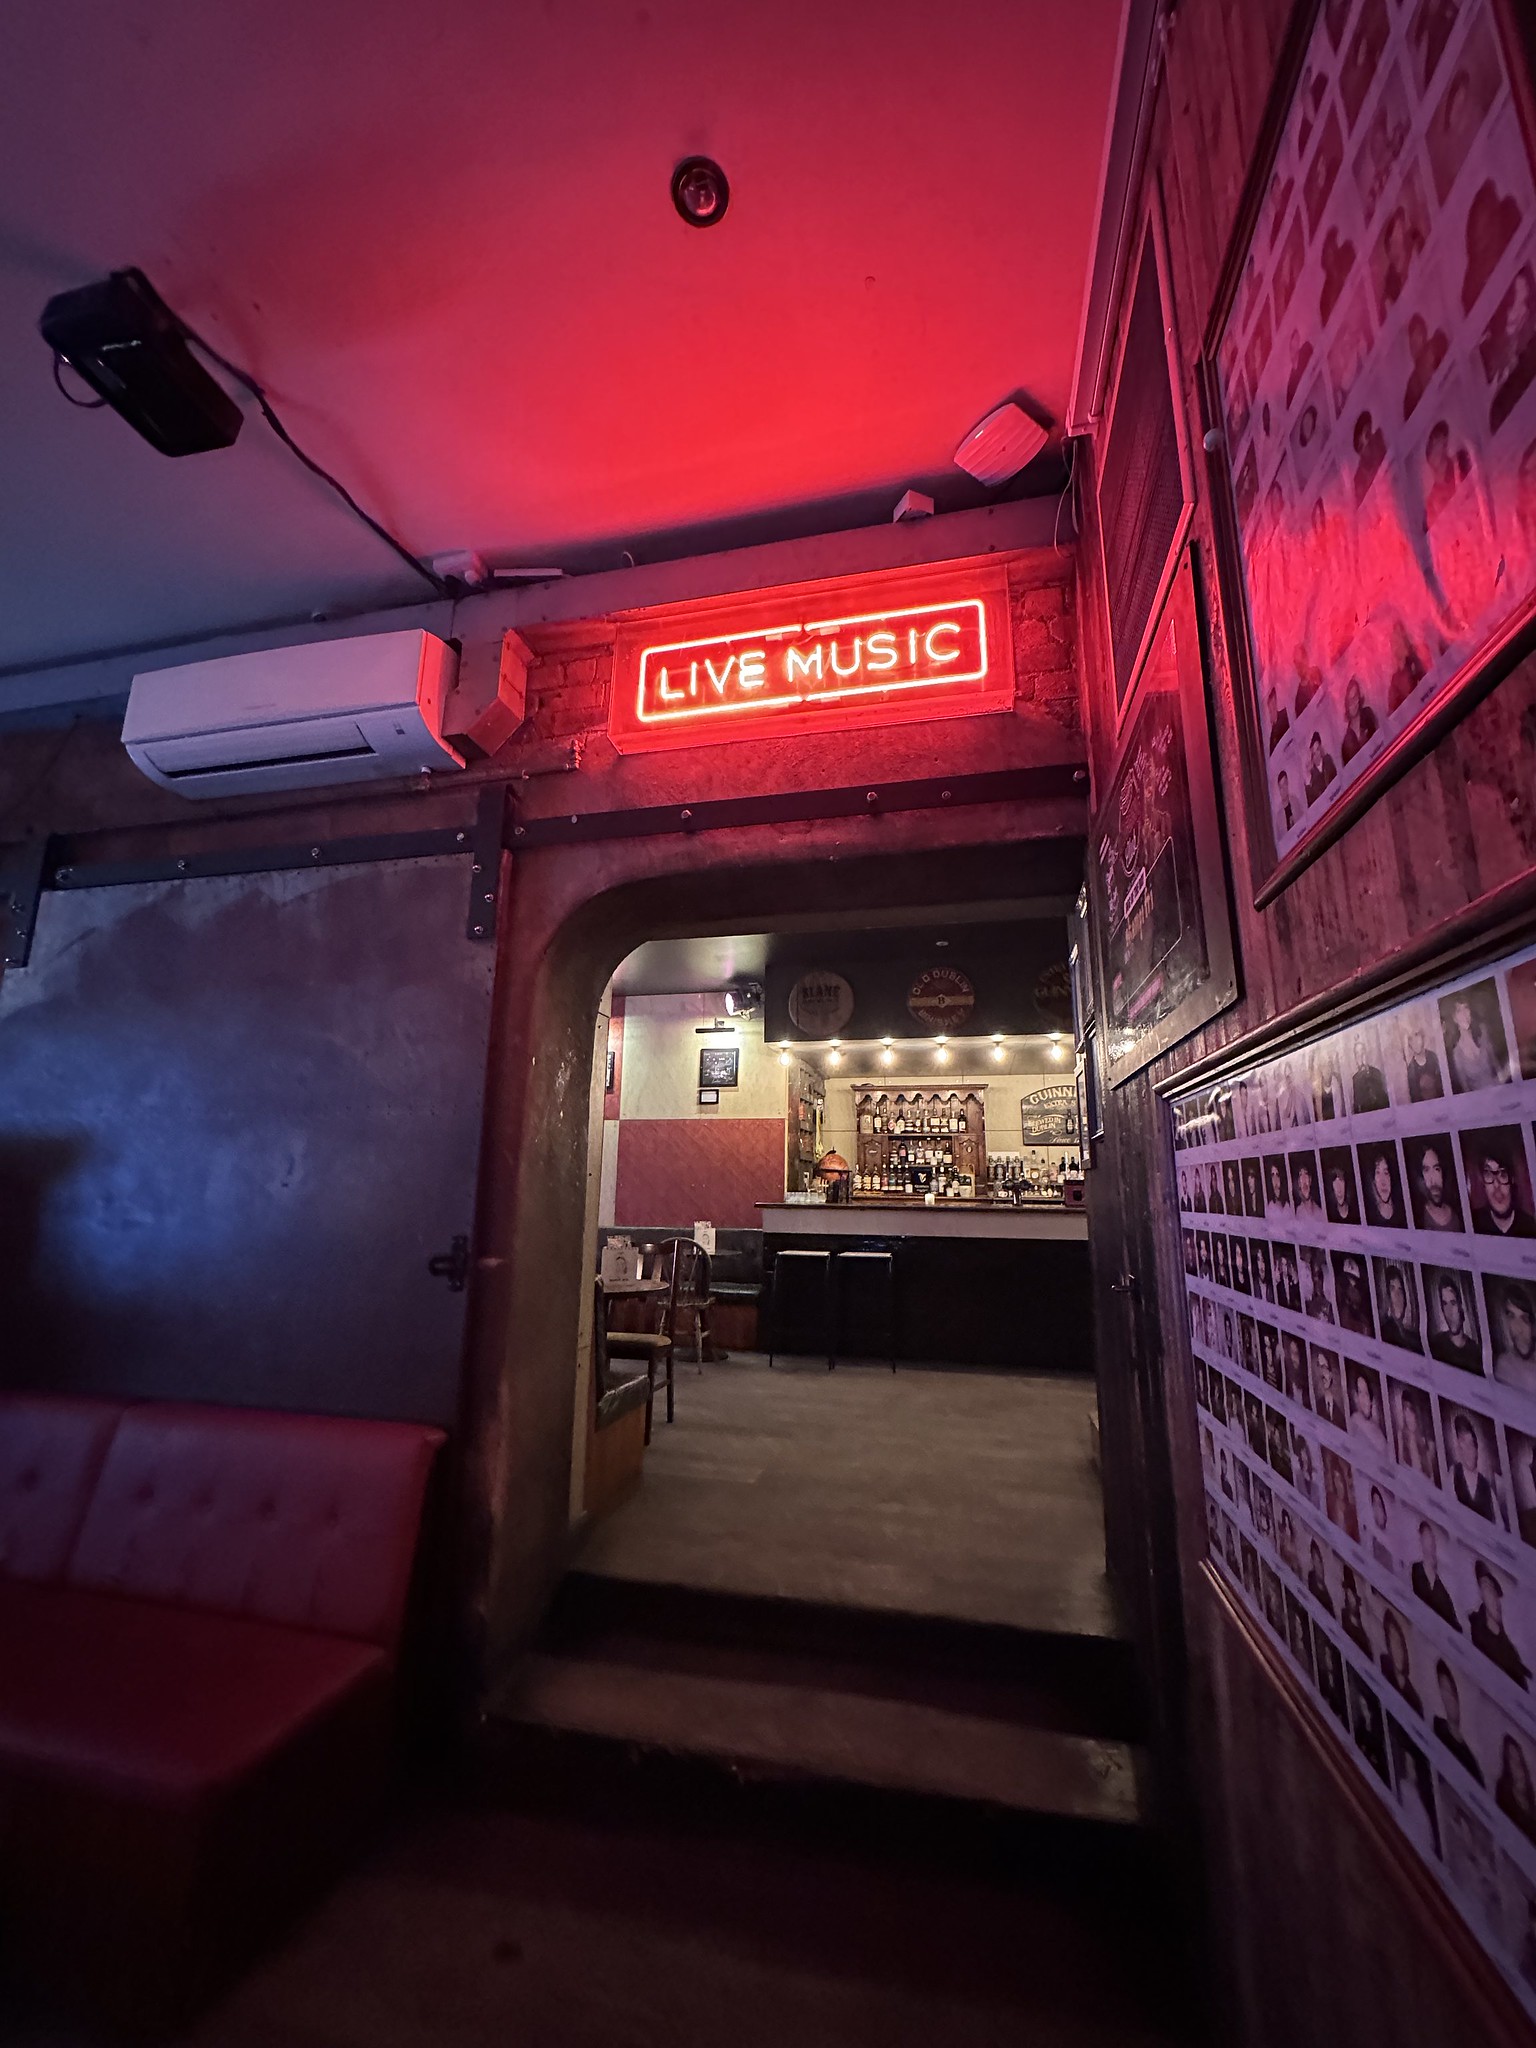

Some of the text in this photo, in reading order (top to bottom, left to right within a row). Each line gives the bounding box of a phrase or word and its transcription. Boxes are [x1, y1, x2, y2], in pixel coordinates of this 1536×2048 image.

[660, 622, 961, 700] LIVE MUSIC
[912, 969, 970, 995] OLD DUBLIN
[1031, 1123, 1056, 1133] DUBLIN
